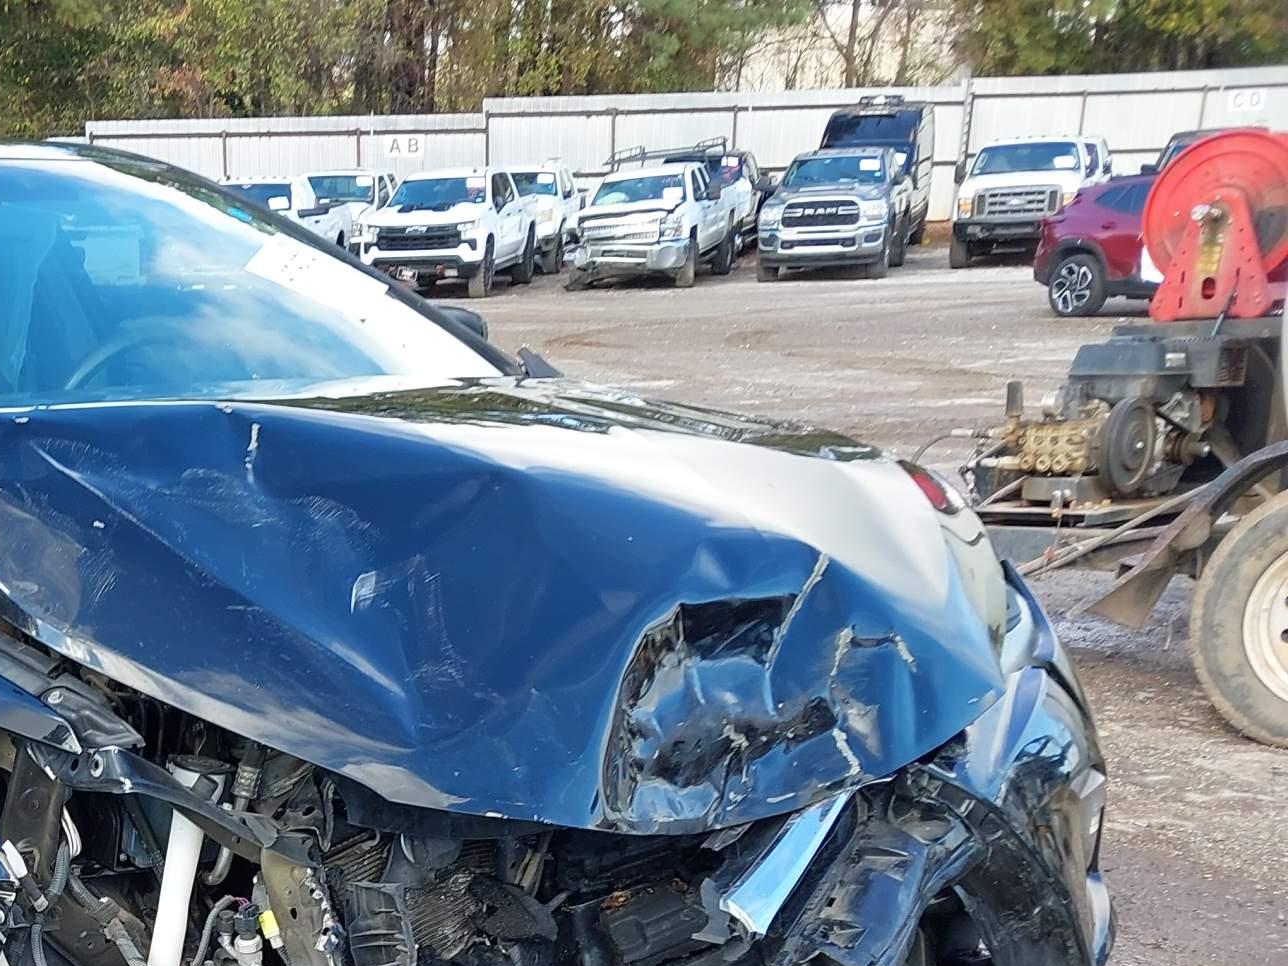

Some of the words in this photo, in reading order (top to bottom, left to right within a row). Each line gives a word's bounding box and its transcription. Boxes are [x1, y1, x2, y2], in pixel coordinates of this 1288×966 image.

[389, 137, 401, 153] A
[408, 137, 419, 153] B
[803, 207, 838, 217] RAM
